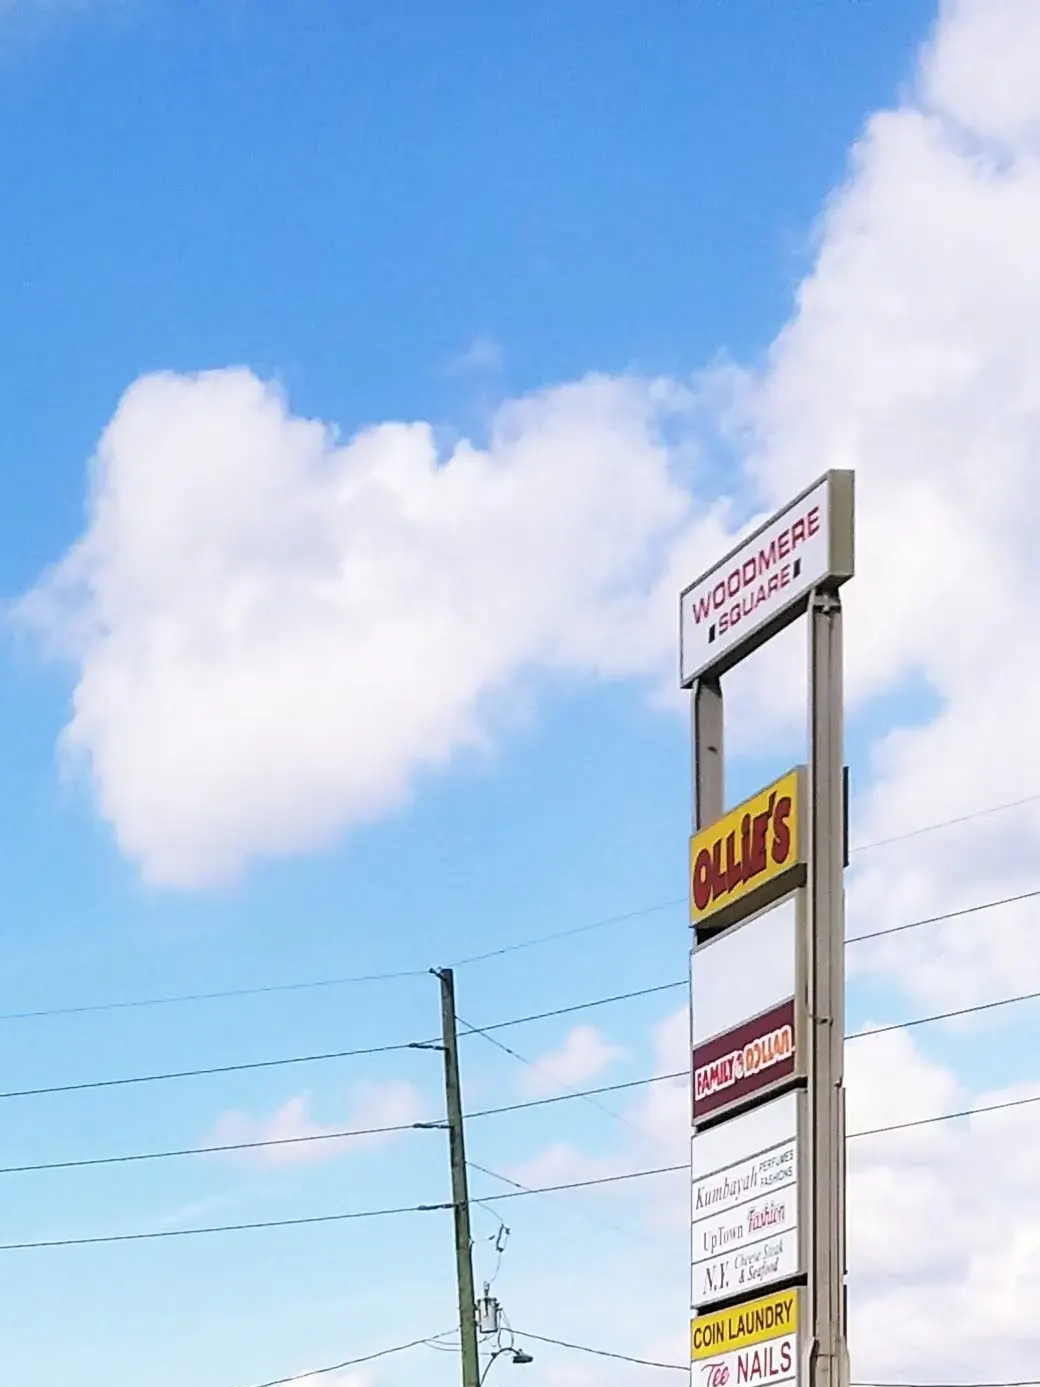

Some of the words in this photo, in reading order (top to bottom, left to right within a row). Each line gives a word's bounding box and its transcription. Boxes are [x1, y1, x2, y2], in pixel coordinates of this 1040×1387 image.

[692, 505, 820, 625] WOODMERE
[718, 563, 791, 636] SQUARE
[695, 1051, 736, 1100] FAMILY
[695, 1165, 758, 1211] Kumbayah
[703, 1224, 743, 1255] UpTown
[747, 1202, 786, 1233] Fashion
[702, 1260, 730, 1295] N.Y.
[693, 1319, 725, 1350] COIN
[728, 1298, 794, 1340] LAUNDRY
[736, 1341, 793, 1385] NAILS
